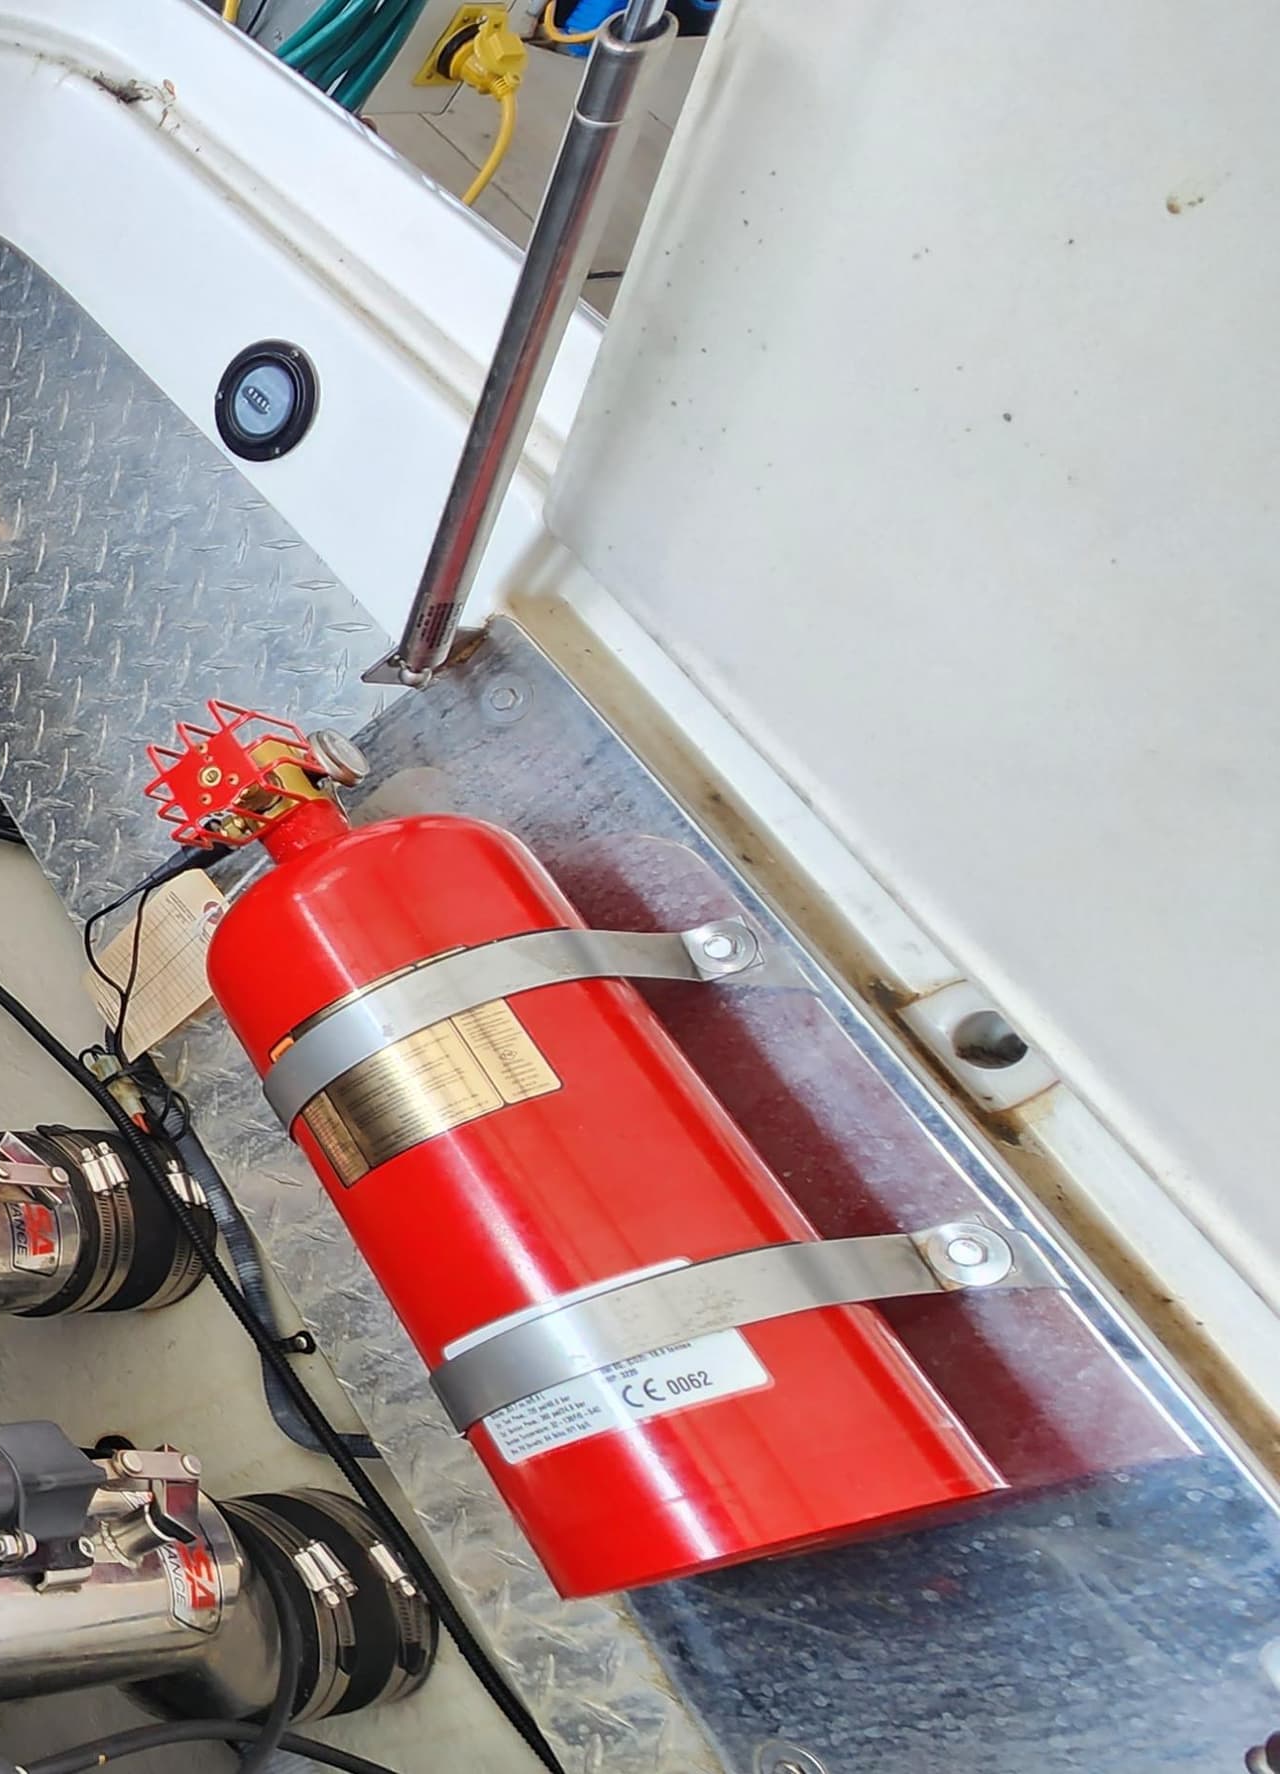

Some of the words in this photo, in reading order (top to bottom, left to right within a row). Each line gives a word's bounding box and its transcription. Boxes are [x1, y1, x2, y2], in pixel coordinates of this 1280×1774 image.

[11, 1202, 28, 1256] ANCE
[666, 1370, 713, 1395] 0062
[163, 1543, 186, 1604] ANCE
